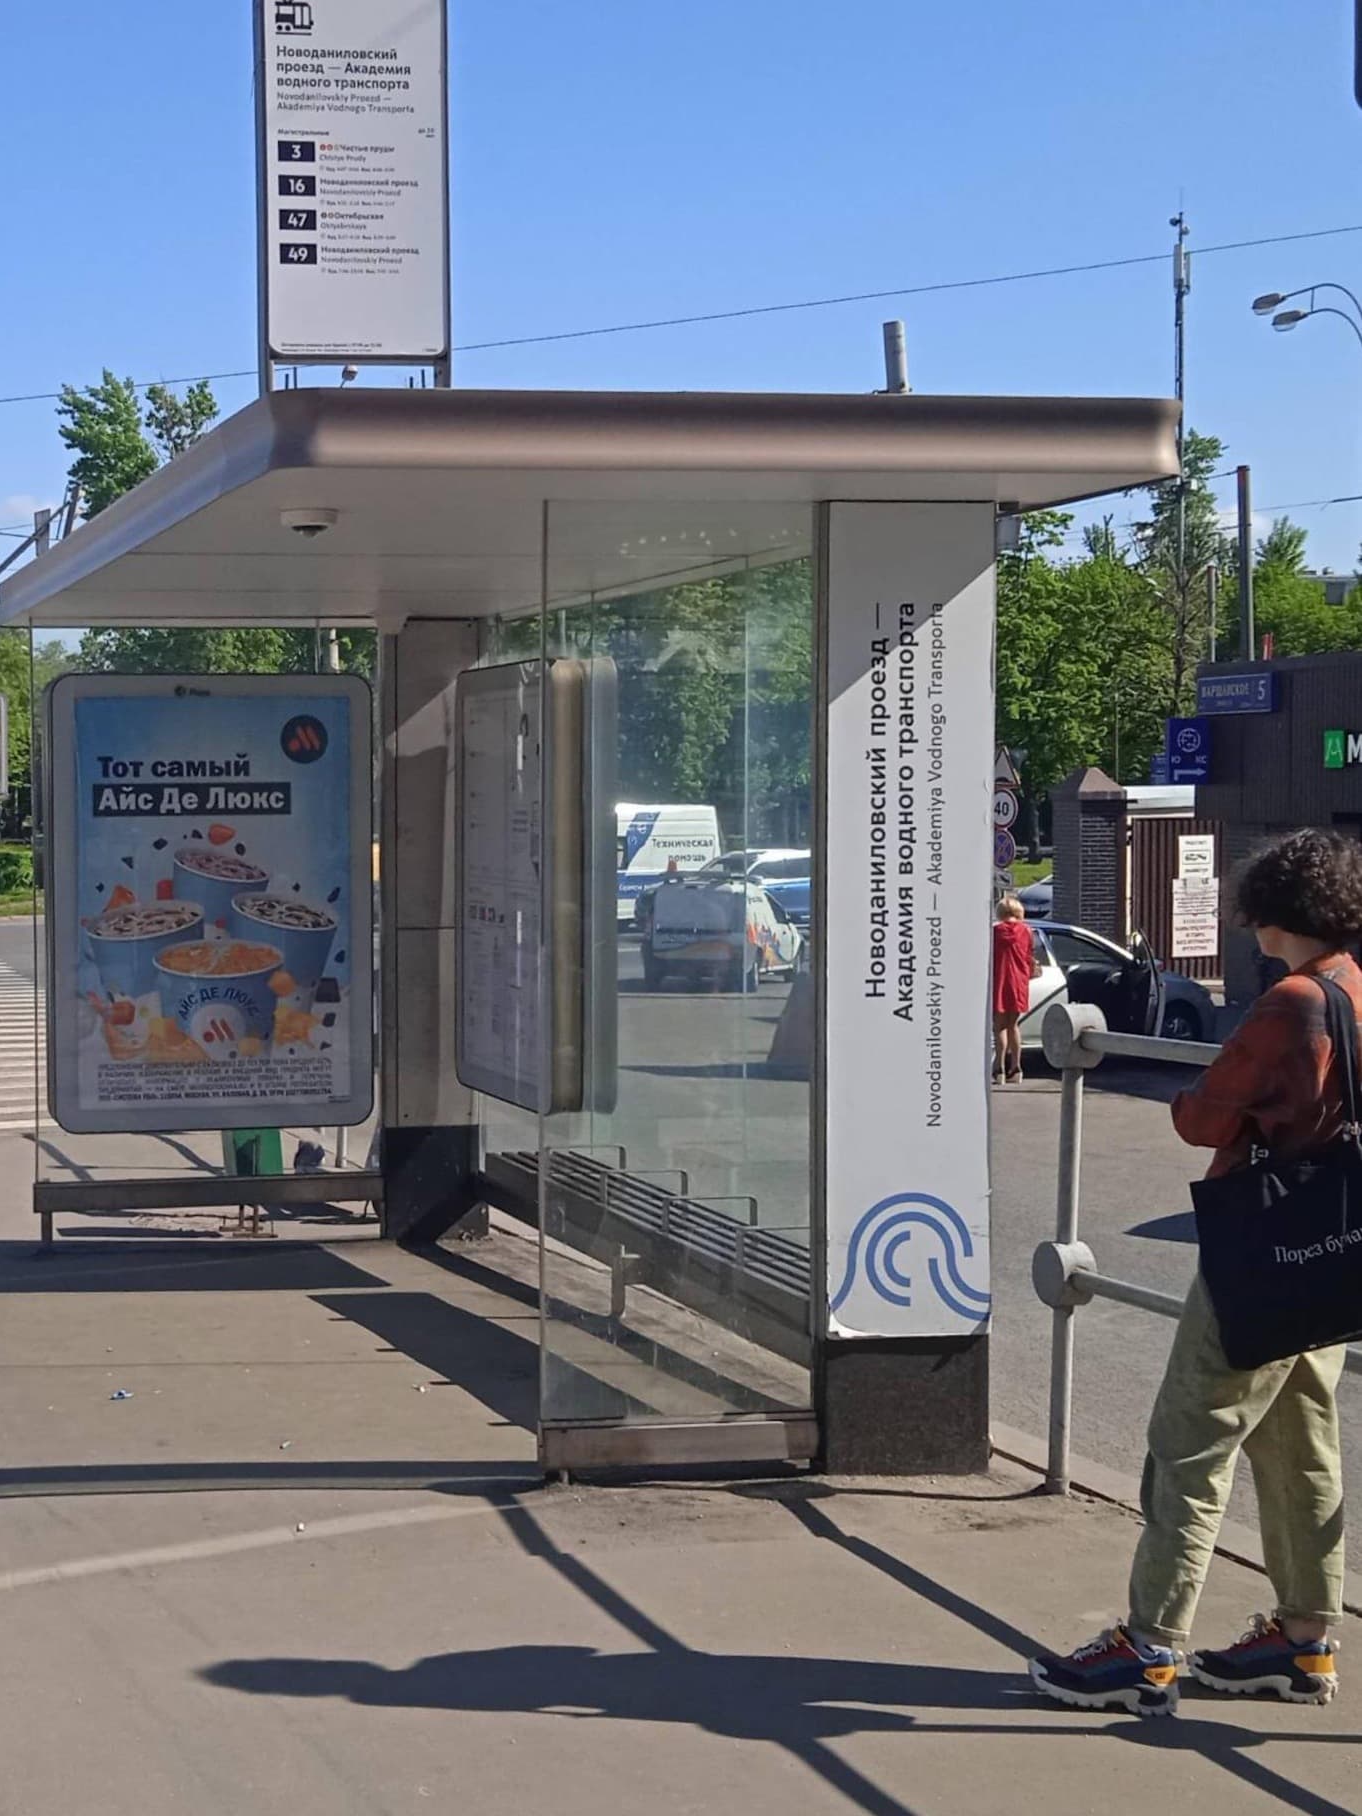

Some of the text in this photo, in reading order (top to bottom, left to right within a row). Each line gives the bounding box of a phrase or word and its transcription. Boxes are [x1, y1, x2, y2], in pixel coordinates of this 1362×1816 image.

[276, 45, 398, 60] Новоданиловский
[276, 62, 325, 74] проезд
[344, 62, 411, 76] Академия
[276, 77, 410, 91] водного транспорта
[326, 103, 366, 114] Vodnogo
[368, 104, 415, 114] Transporta
[291, 144, 302, 159] 3
[288, 178, 306, 194] 16
[287, 213, 308, 228] 47
[288, 247, 308, 262] 49
[927, 602, 947, 699] Transporta
[871, 637, 891, 737] проезд
[1257, 679, 1267, 701] 5
[927, 703, 947, 782] Vodnogo
[97, 753, 251, 778] Тот самый
[98, 786, 286, 814] Айс Де Люкс
[994, 801, 1010, 817] 40
[892, 602, 919, 1022] Академия водного транспорта
[652, 838, 714, 849] Техническая
[927, 787, 946, 885] Akademiya
[865, 747, 890, 998] Новоданиловский
[926, 917, 942, 977] Proezd
[199, 986, 220, 1002] ДЕ
[926, 981, 945, 1127] Novodanilovskiy
